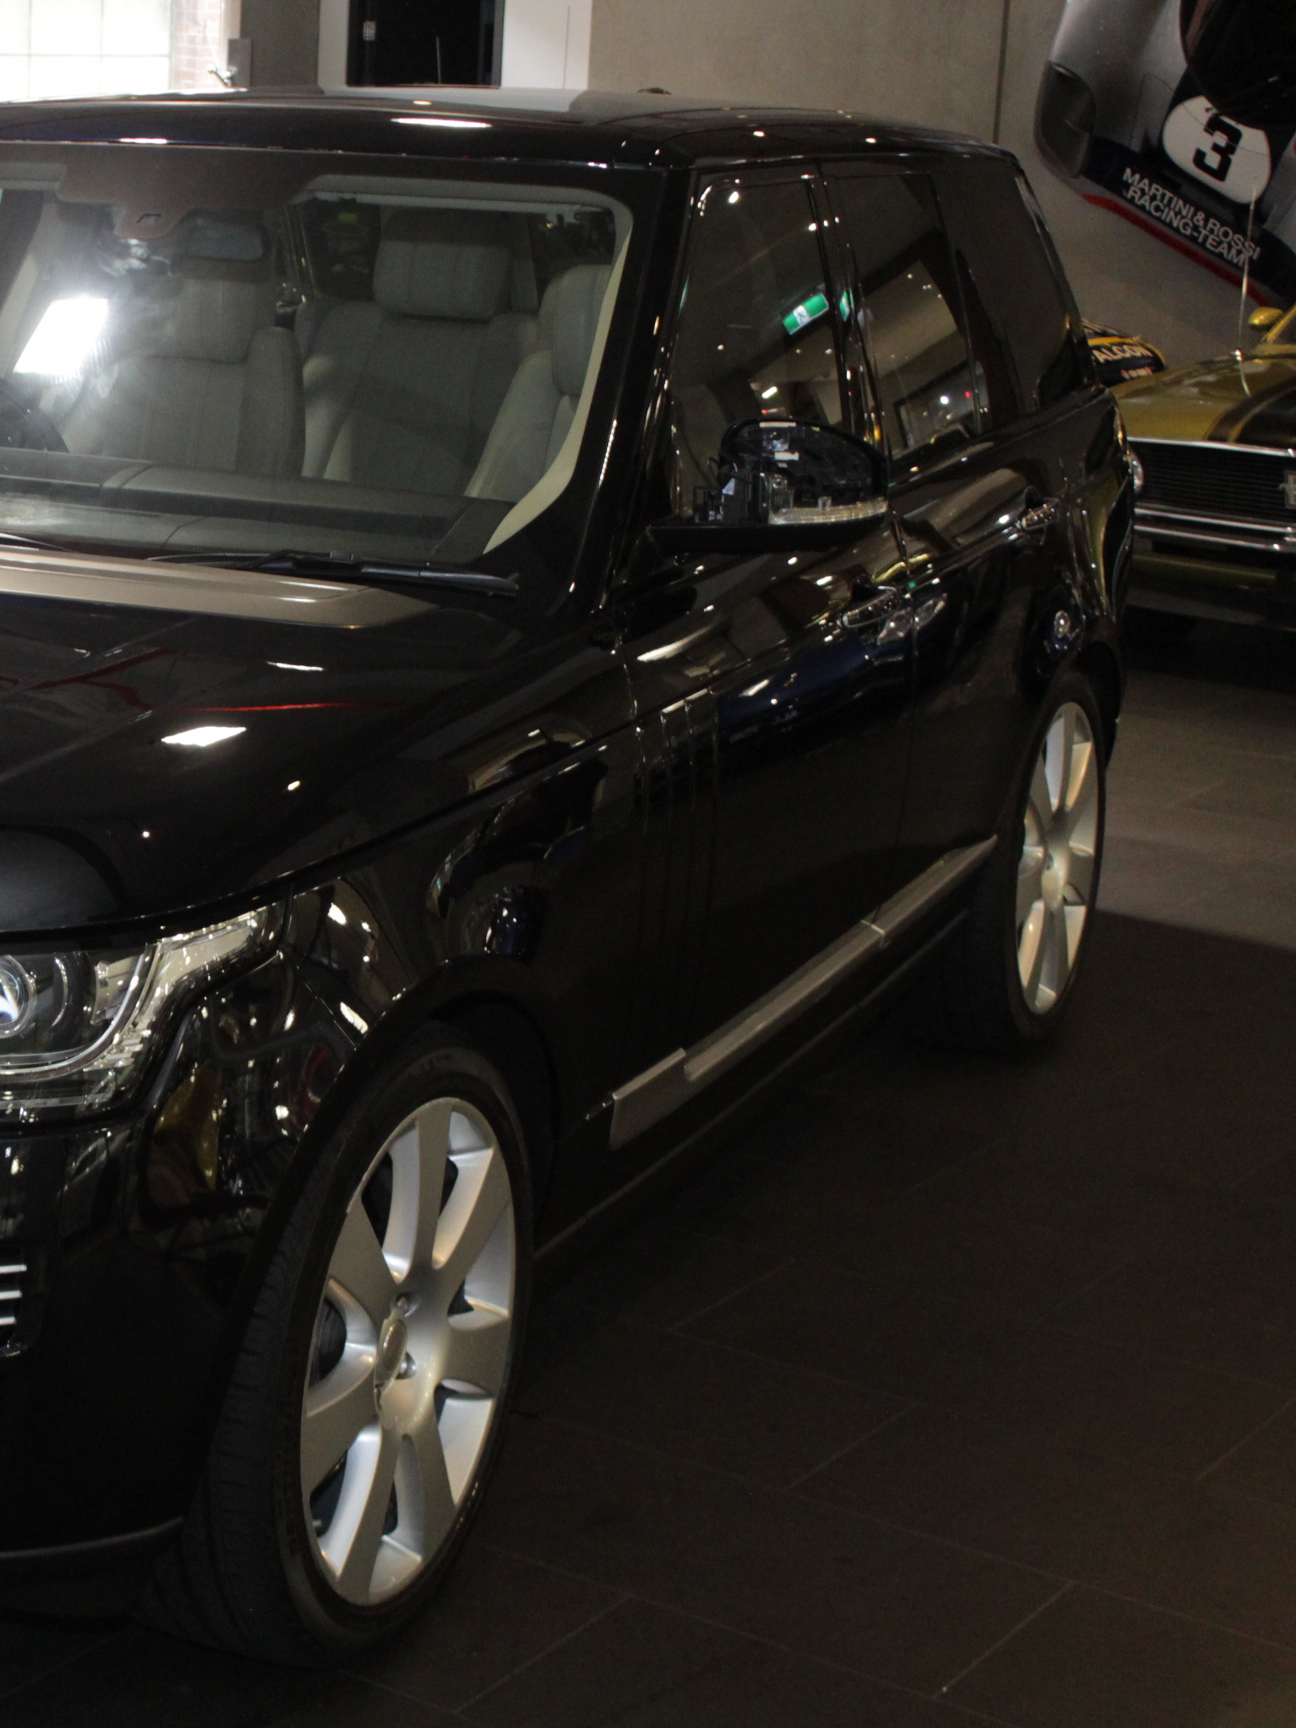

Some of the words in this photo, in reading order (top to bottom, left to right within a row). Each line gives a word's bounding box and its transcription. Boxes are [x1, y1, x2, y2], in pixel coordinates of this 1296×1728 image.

[1192, 112, 1243, 182] 3
[1123, 167, 1195, 219] MARTINI
[1193, 211, 1206, 228] &
[1206, 218, 1261, 260] ROSSI
[1127, 186, 1247, 267] RACING-TEAM
[1091, 345, 1153, 363] ALCON
